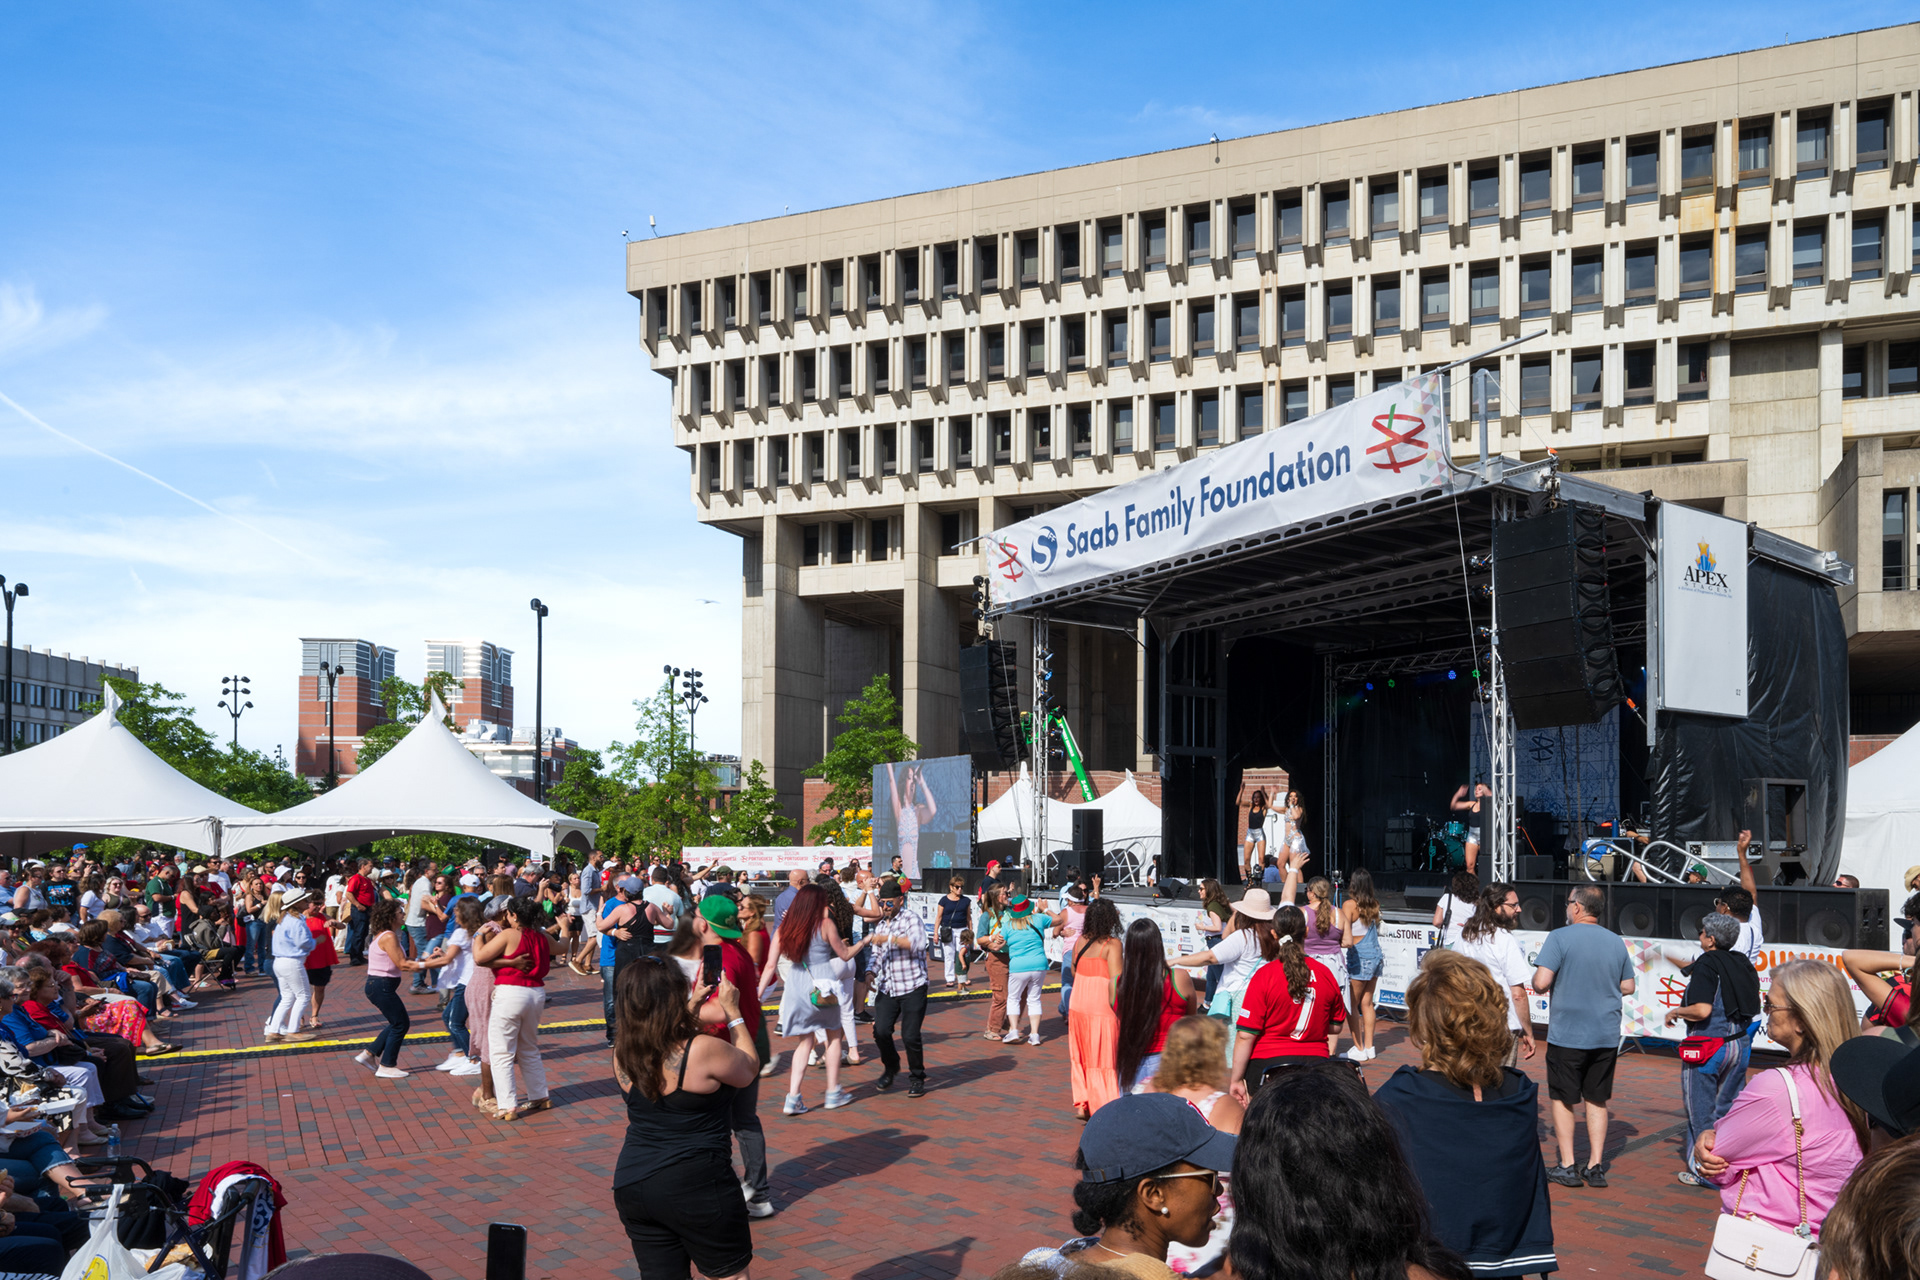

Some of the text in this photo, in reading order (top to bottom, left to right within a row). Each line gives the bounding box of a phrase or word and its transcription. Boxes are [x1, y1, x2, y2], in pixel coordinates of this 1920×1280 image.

[1066, 441, 1351, 558] Saab Family Foundation
[1684, 565, 1729, 589] APEX
[1684, 582, 1728, 594] STAGES
